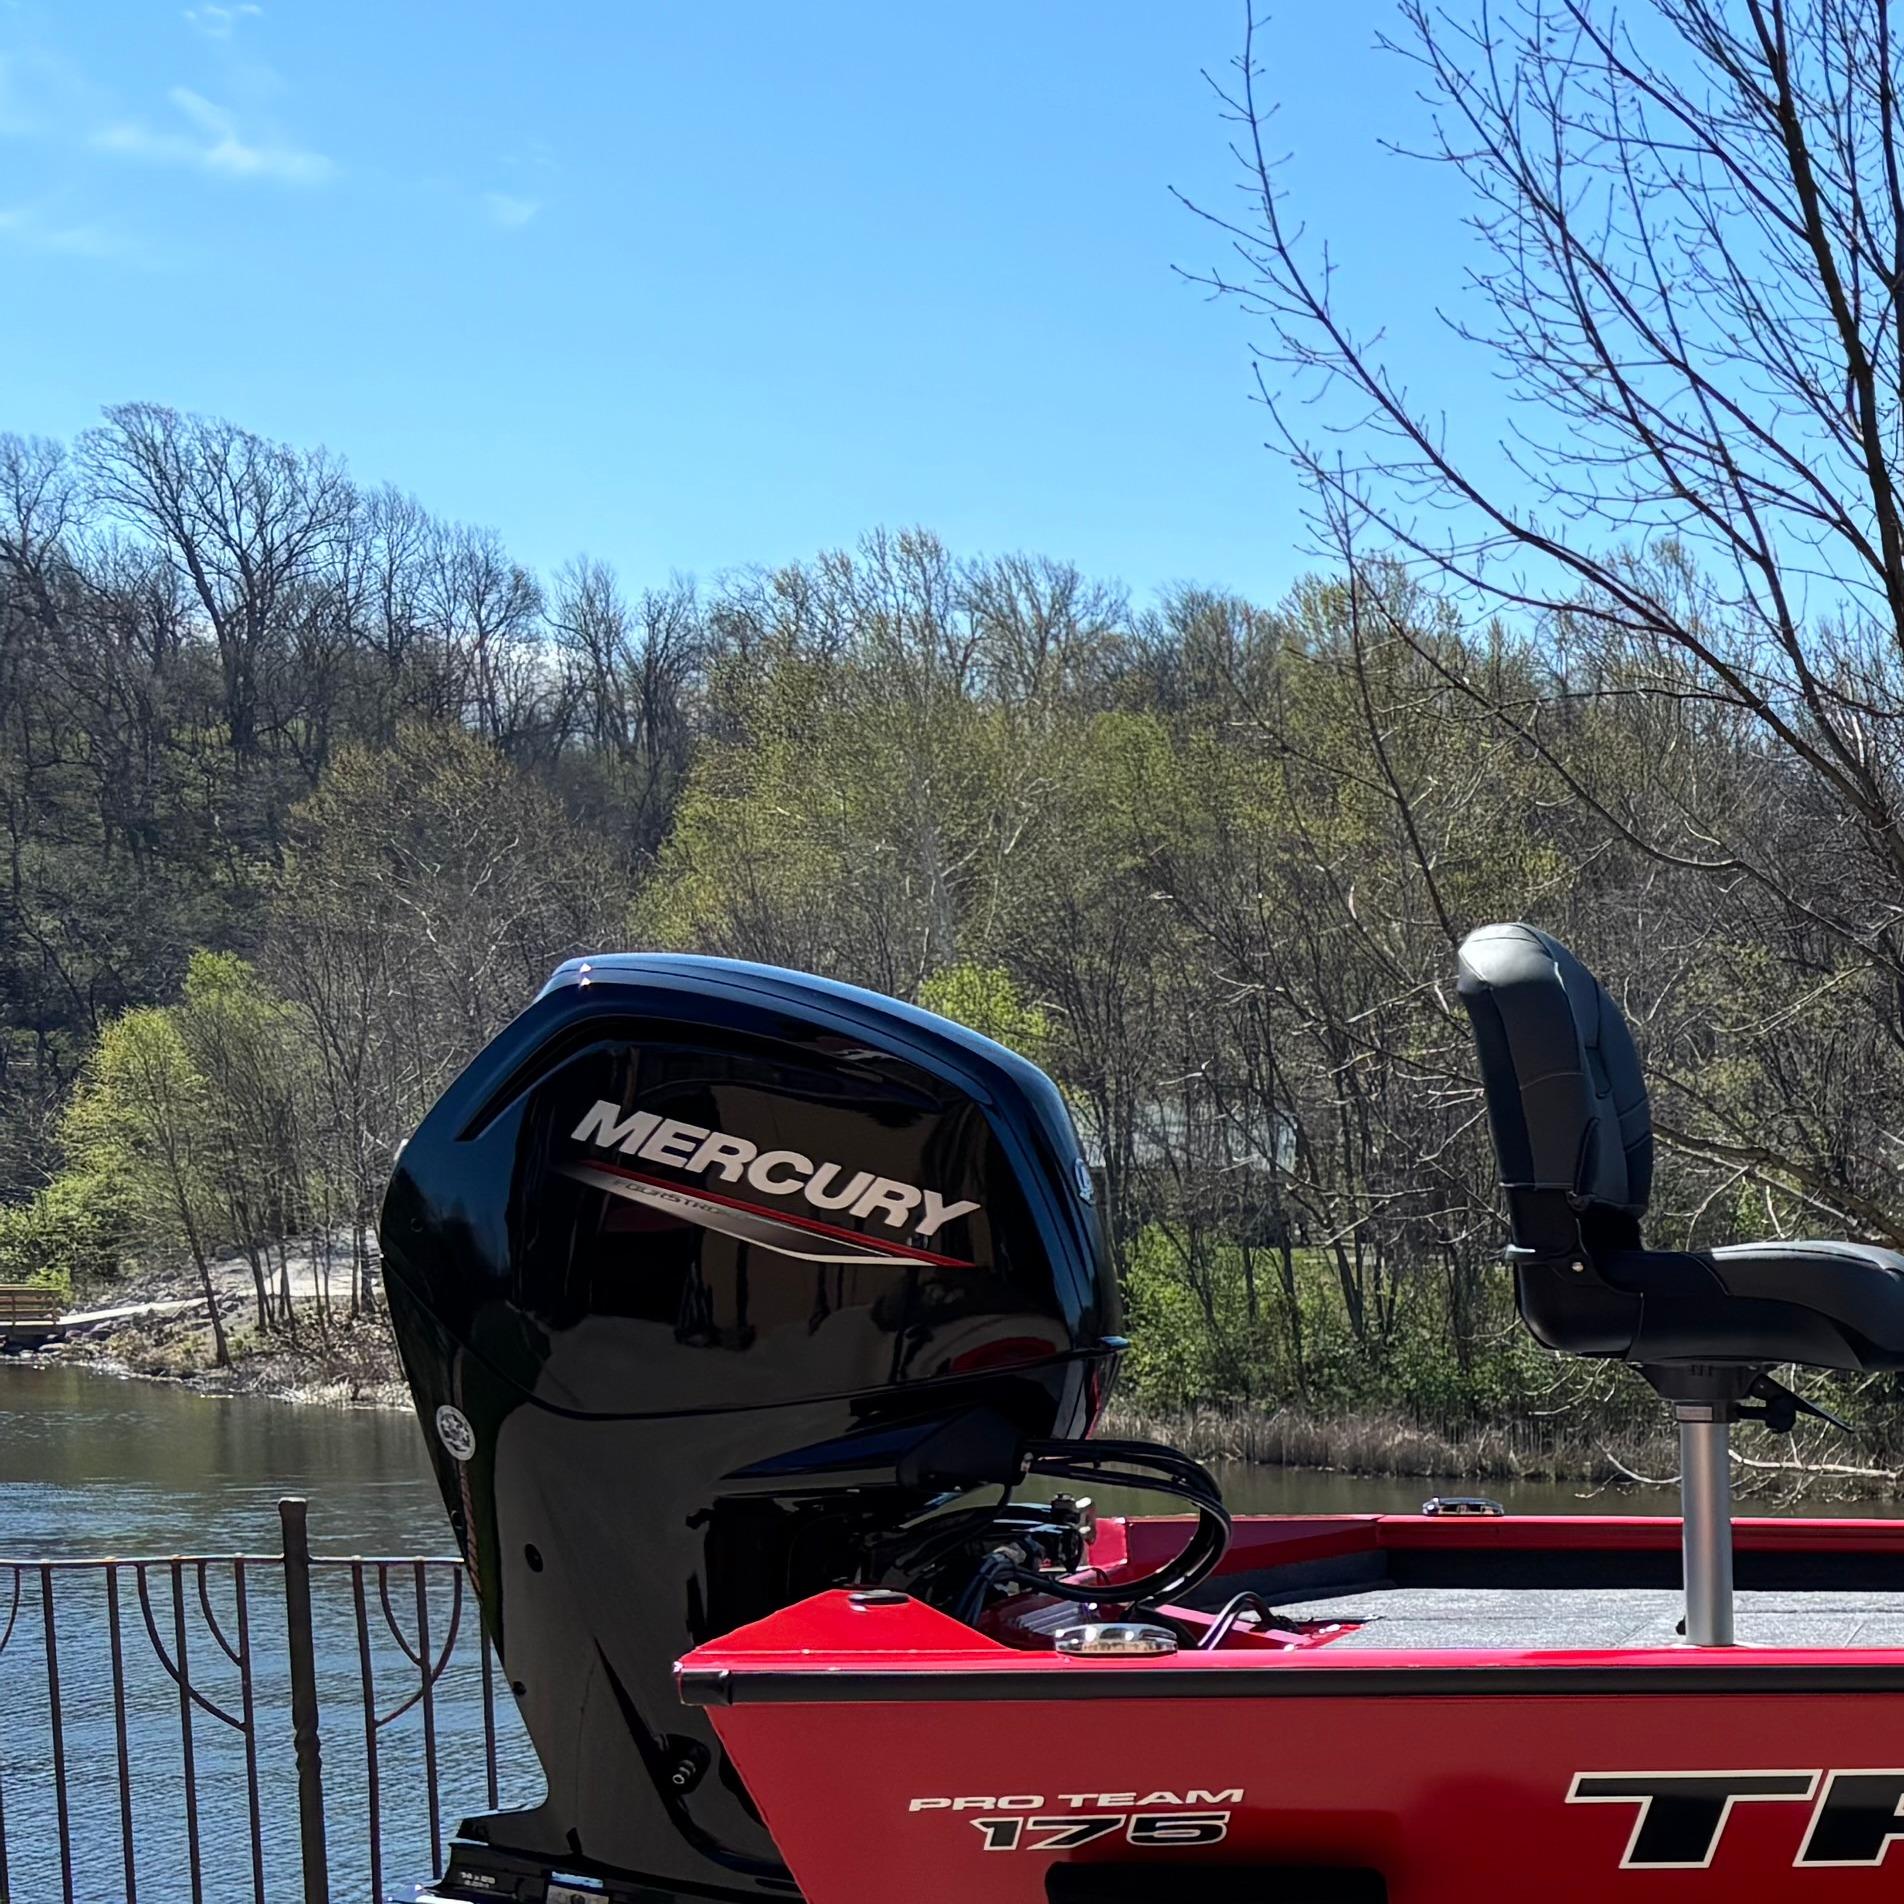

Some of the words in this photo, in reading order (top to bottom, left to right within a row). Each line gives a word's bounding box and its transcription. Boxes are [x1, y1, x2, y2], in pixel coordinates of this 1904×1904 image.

[570, 1100, 981, 1236] MERCURY
[908, 1795, 1045, 1812] PRO
[1058, 1789, 1244, 1808] TEAM
[969, 1811, 1231, 1851] 175
